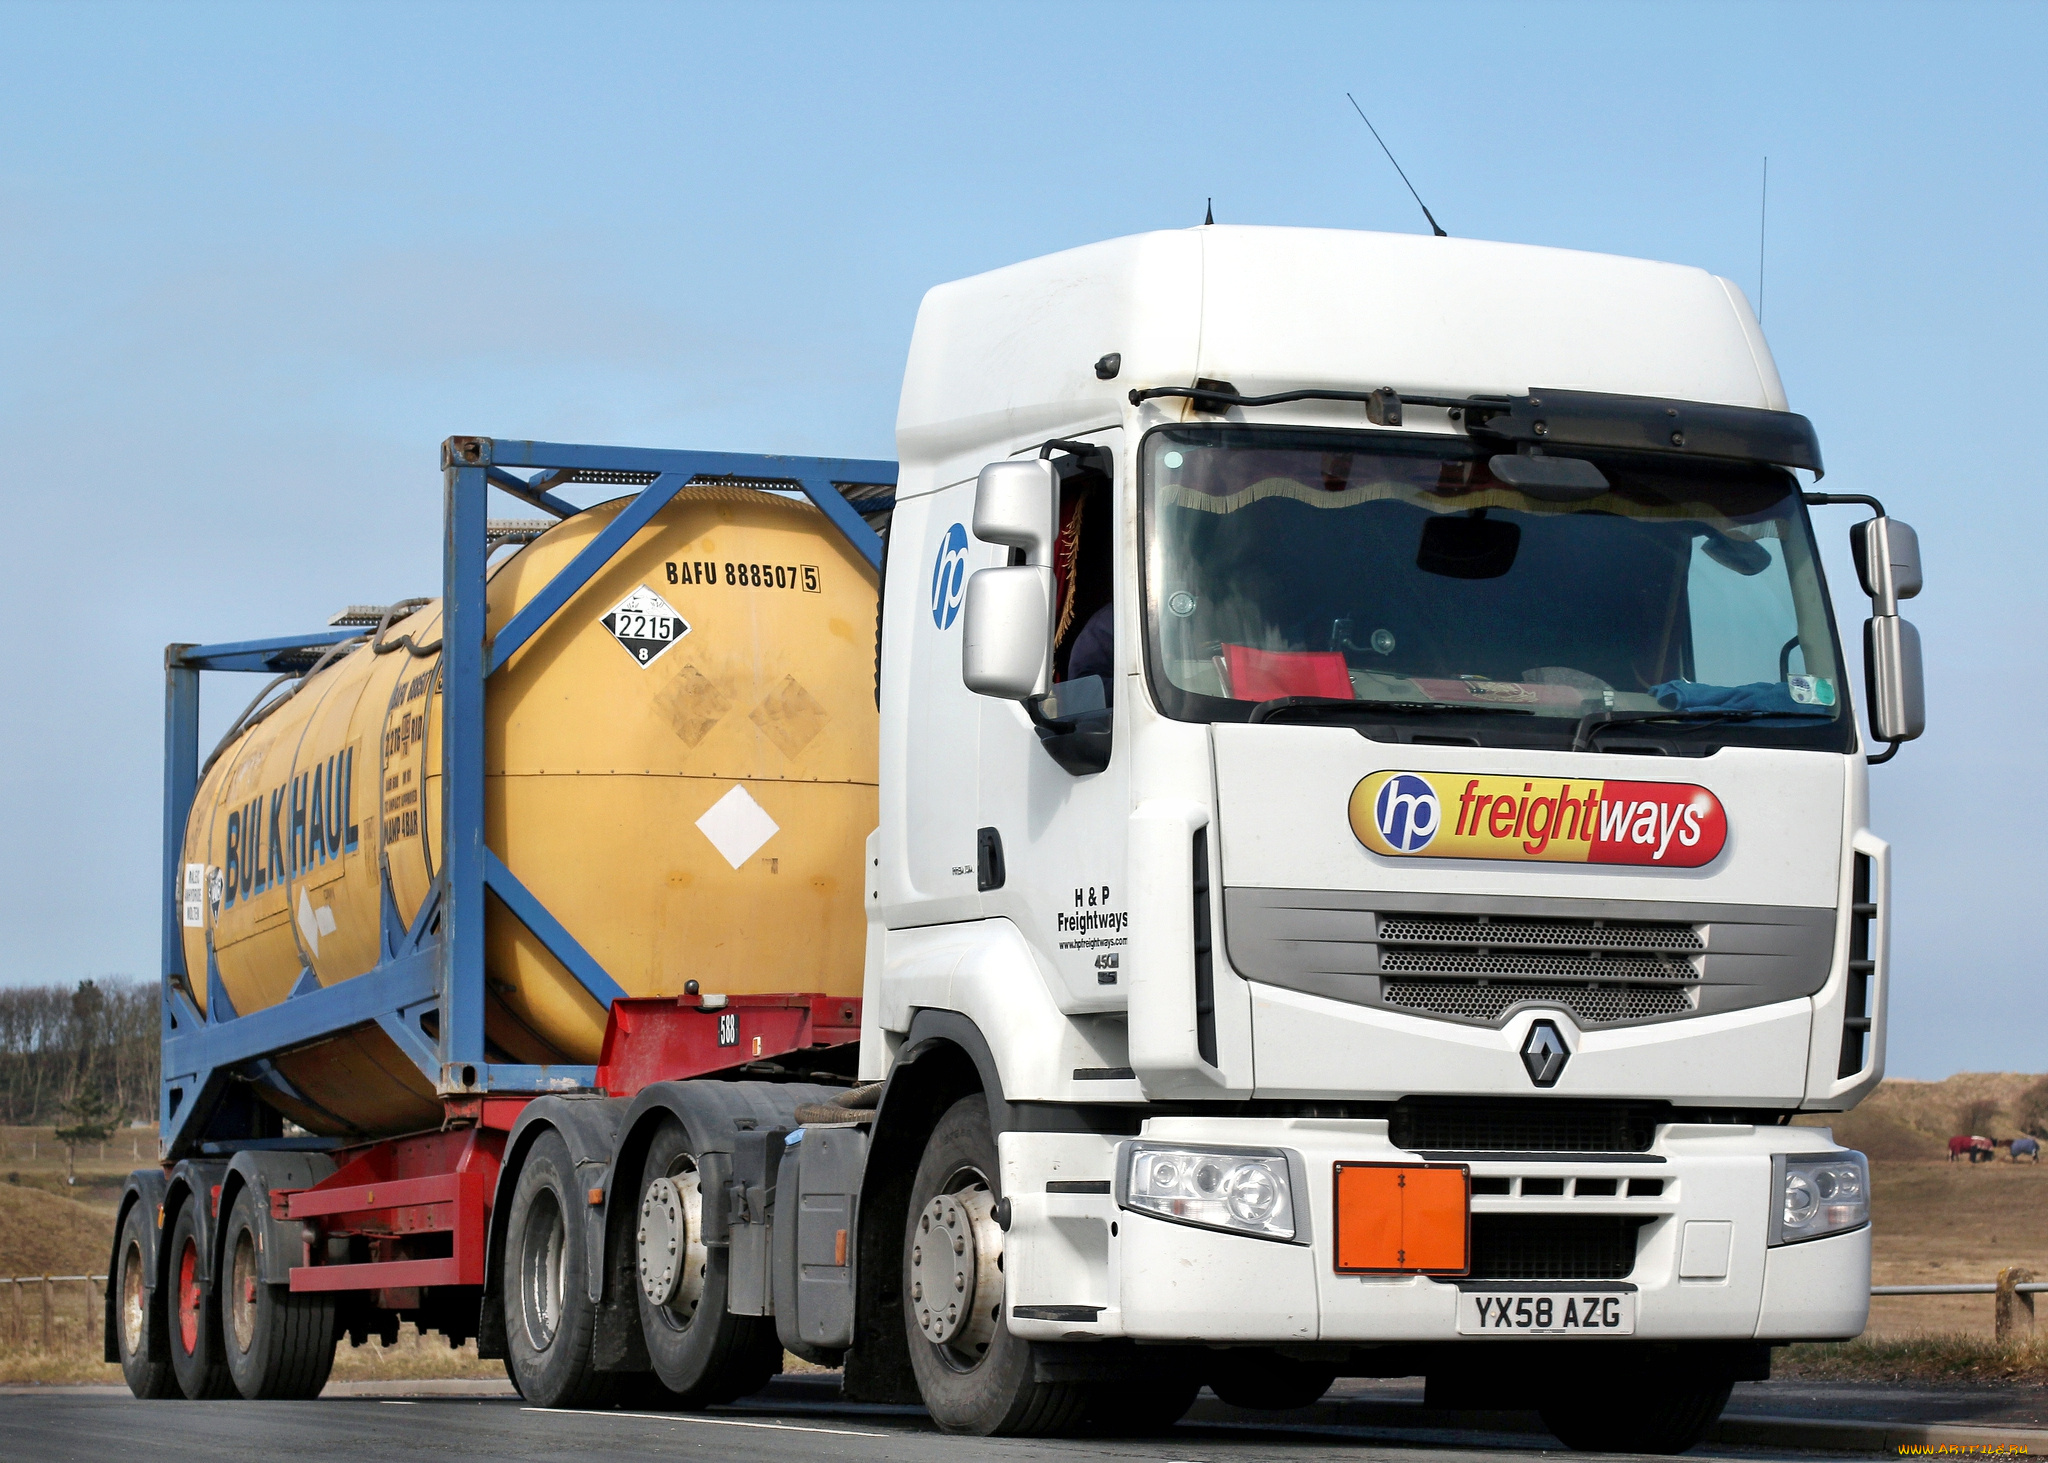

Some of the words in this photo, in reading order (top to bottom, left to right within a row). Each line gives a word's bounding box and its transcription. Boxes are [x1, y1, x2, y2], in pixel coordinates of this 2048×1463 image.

[666, 562, 717, 585] BAFU
[725, 563, 797, 589] 888507
[804, 567, 817, 590] 5
[619, 615, 671, 639] 2215
[638, 647, 649, 661] 8
[225, 782, 287, 909] BULK
[290, 745, 358, 880] HAUL
[1382, 779, 1440, 852] hp
[1075, 888, 1083, 907] H
[1088, 886, 1097, 906] &
[1102, 885, 1110, 905] P
[1057, 910, 1128, 935] Freightways
[1059, 937, 1128, 951] www.hpfreightways.com
[720, 1013, 735, 1045] 588
[1475, 1297, 1553, 1328] YX58
[1563, 1297, 1620, 1328] AZG
